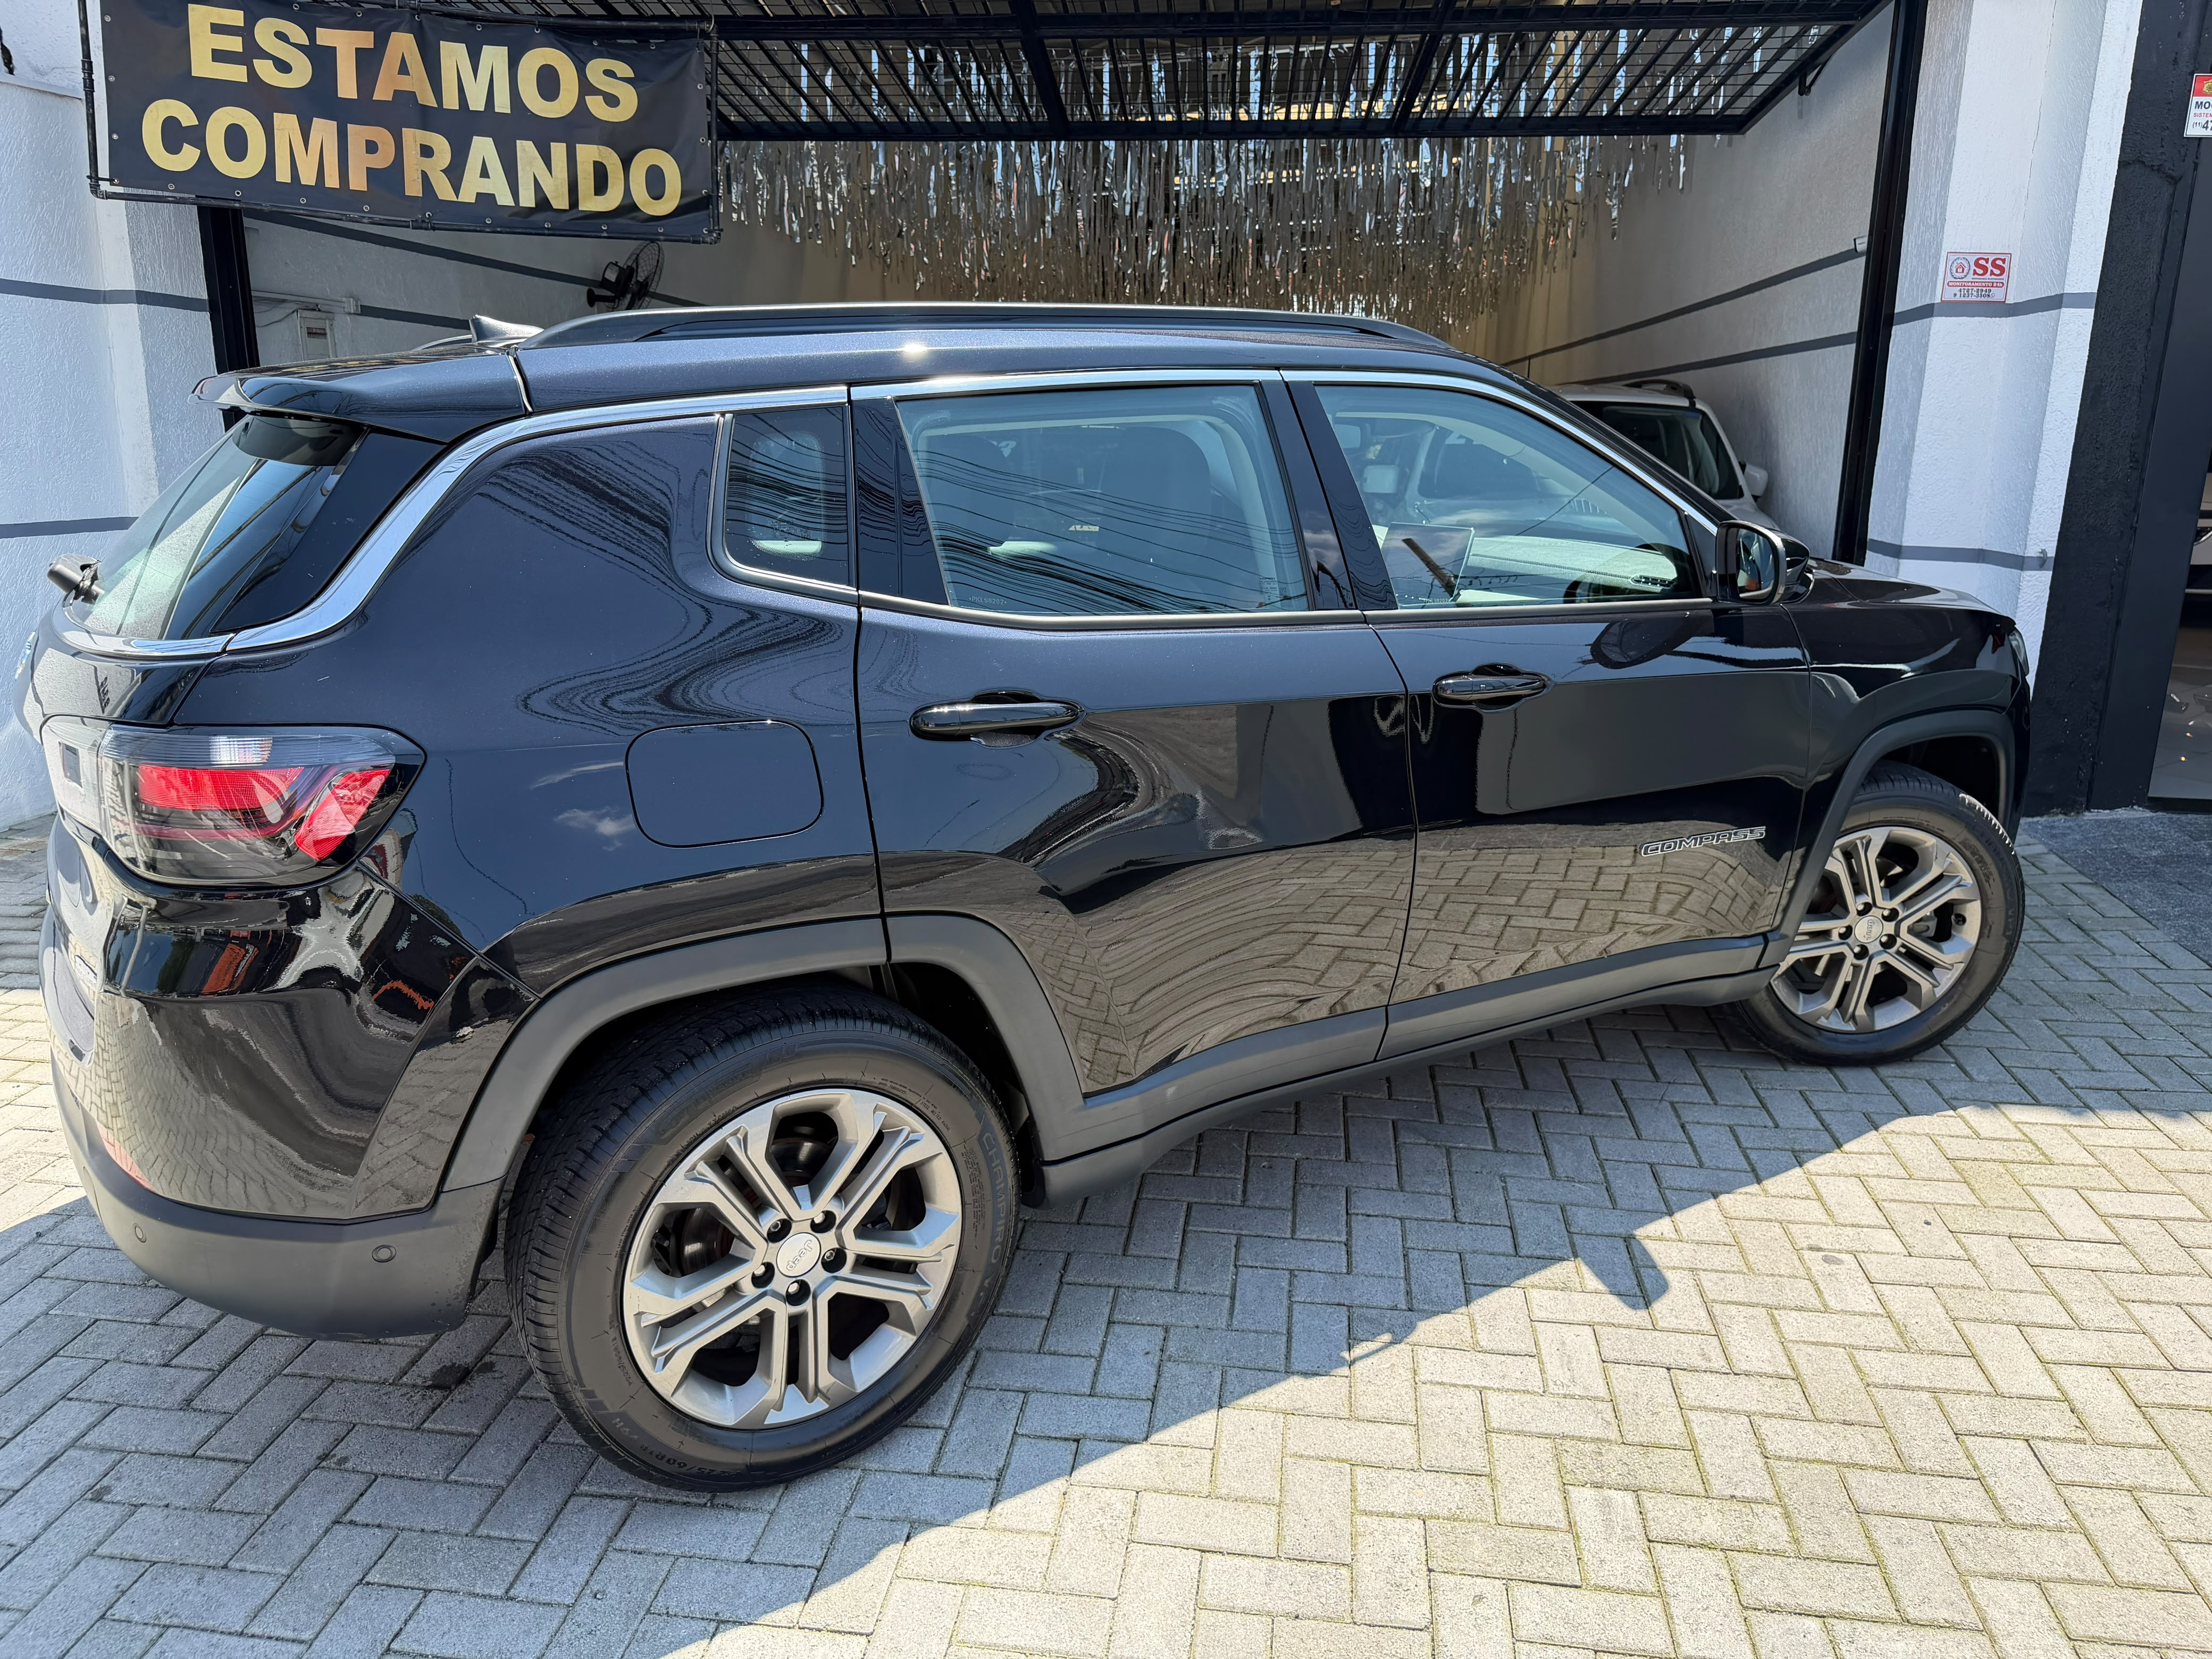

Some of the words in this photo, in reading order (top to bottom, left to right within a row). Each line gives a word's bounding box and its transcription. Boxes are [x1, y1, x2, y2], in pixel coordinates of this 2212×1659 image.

[187, 3, 639, 123] ESTAMOS
[141, 99, 682, 216] COMPRANDO
[1972, 257, 2006, 277] SS
[1640, 826, 1766, 857] COMPASS
[1863, 919, 1875, 941] Jeep
[983, 1132, 1006, 1263] CHAMPIRO
[786, 1239, 812, 1271] Jeep
